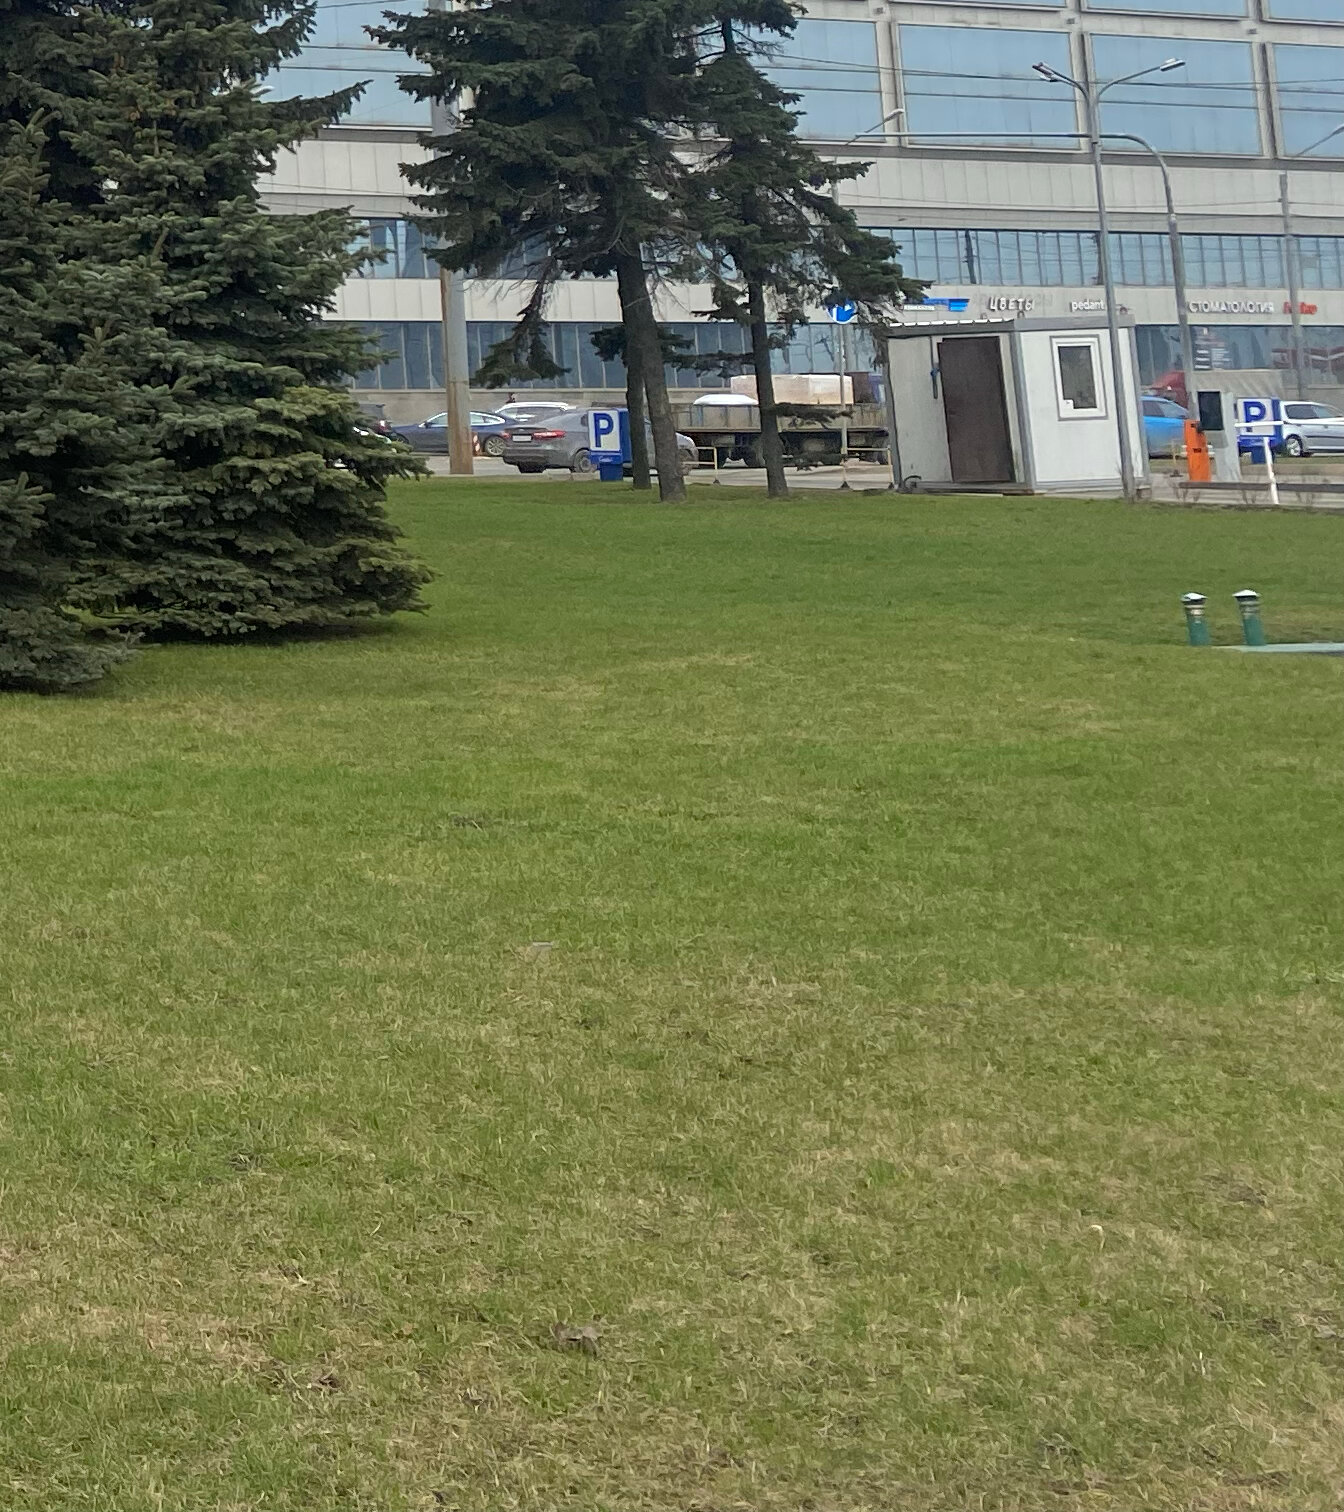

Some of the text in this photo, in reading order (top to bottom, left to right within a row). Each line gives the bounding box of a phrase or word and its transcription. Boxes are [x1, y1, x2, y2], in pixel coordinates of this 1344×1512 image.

[989, 296, 1035, 312] ЦВЕТЫ
[1188, 300, 1275, 314] СТОМАТОЛОГИЯ
[1243, 401, 1267, 433] P
[593, 413, 614, 448] P
